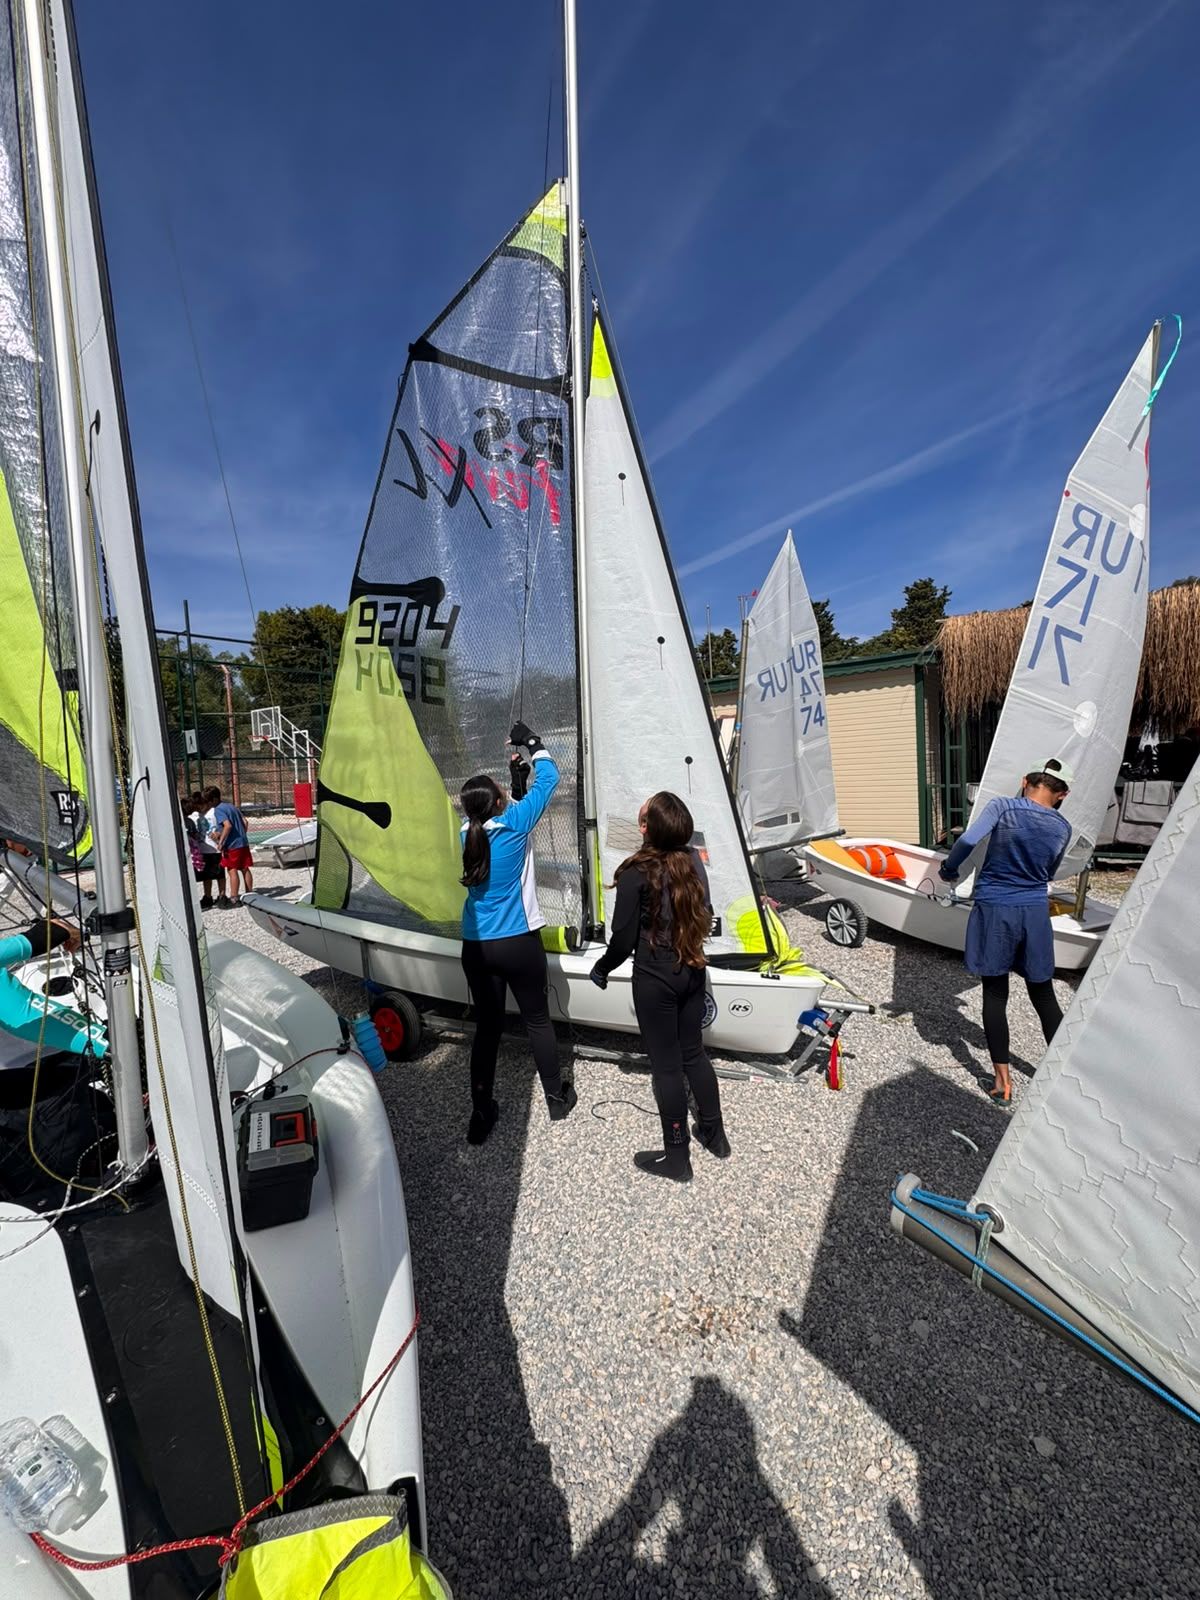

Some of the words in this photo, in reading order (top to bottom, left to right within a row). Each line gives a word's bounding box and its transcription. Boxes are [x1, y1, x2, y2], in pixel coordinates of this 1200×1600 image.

[1043, 556, 1100, 626] 71
[354, 600, 461, 649] 9204
[800, 700, 825, 735] 74
[731, 1004, 750, 1012] RS
